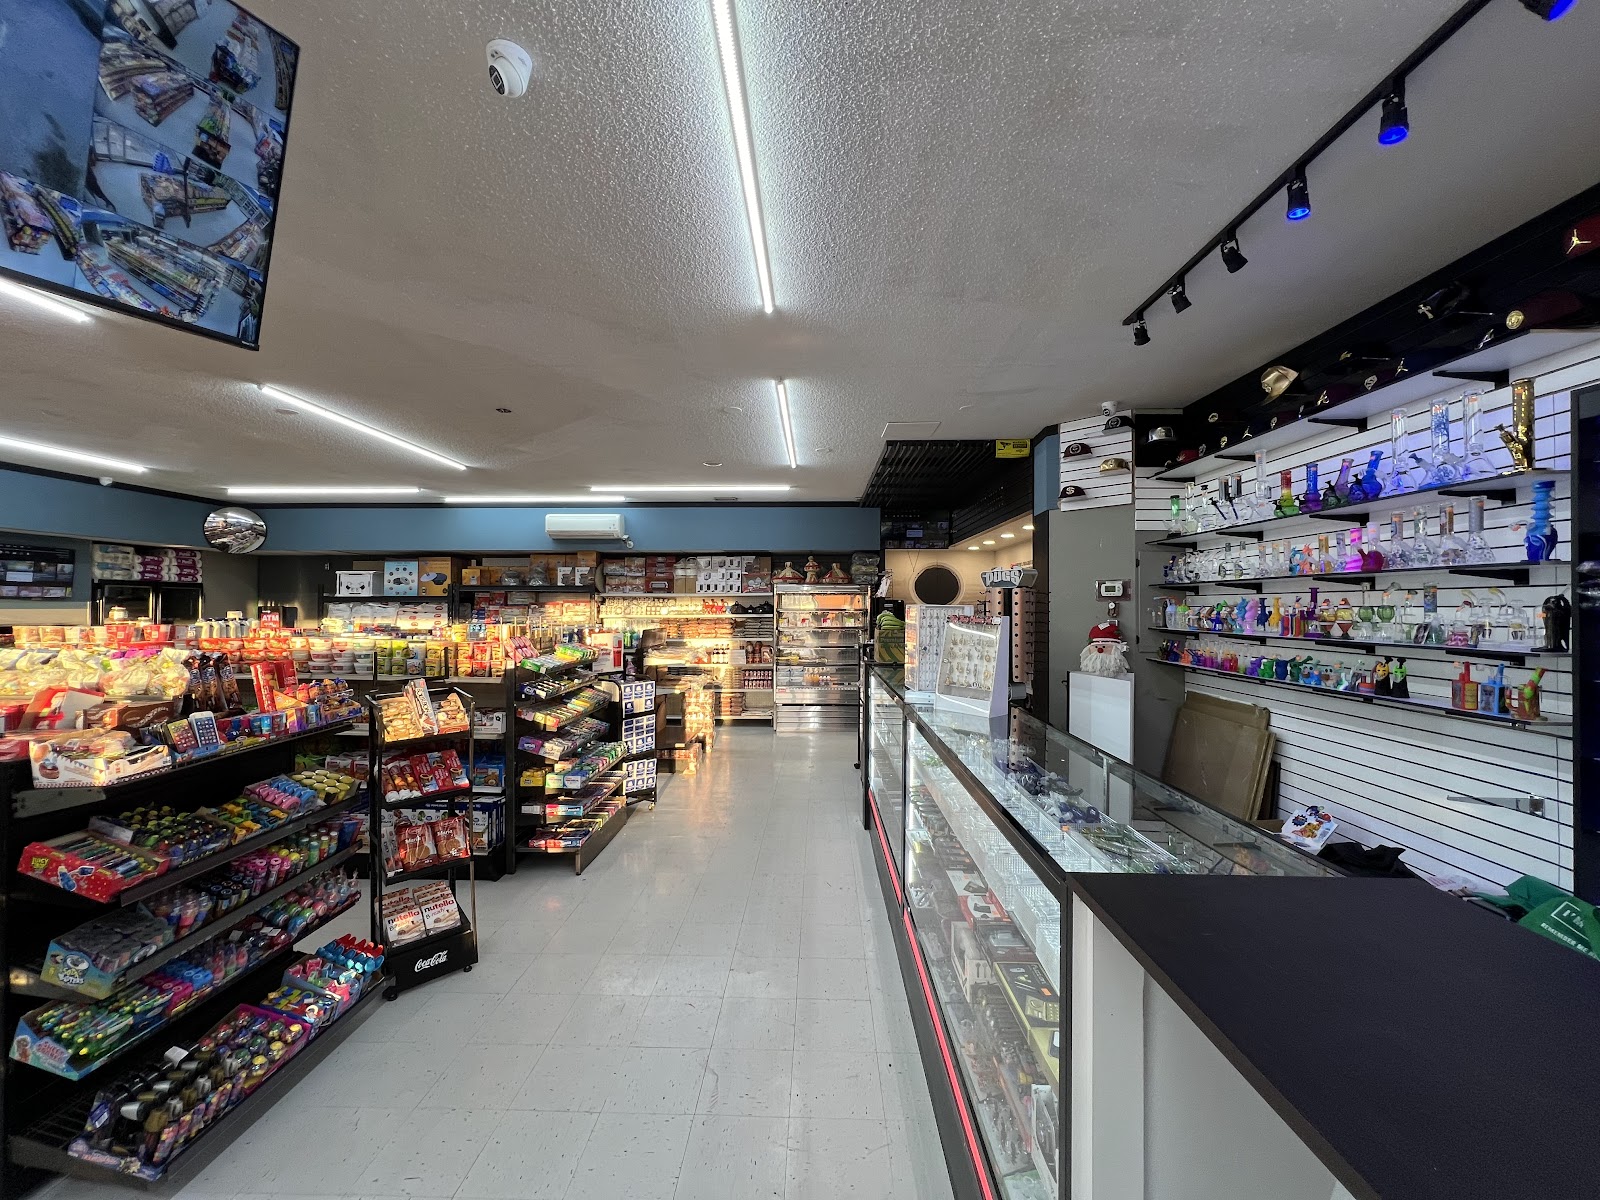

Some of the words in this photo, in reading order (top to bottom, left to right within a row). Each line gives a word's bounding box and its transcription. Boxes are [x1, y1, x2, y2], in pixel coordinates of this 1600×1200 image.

[982, 569, 1021, 587] PUGS
[262, 614, 280, 622] ATM
[424, 899, 455, 913] nutella
[387, 911, 420, 925] nutella
[1541, 922, 1576, 946] REMEMBER
